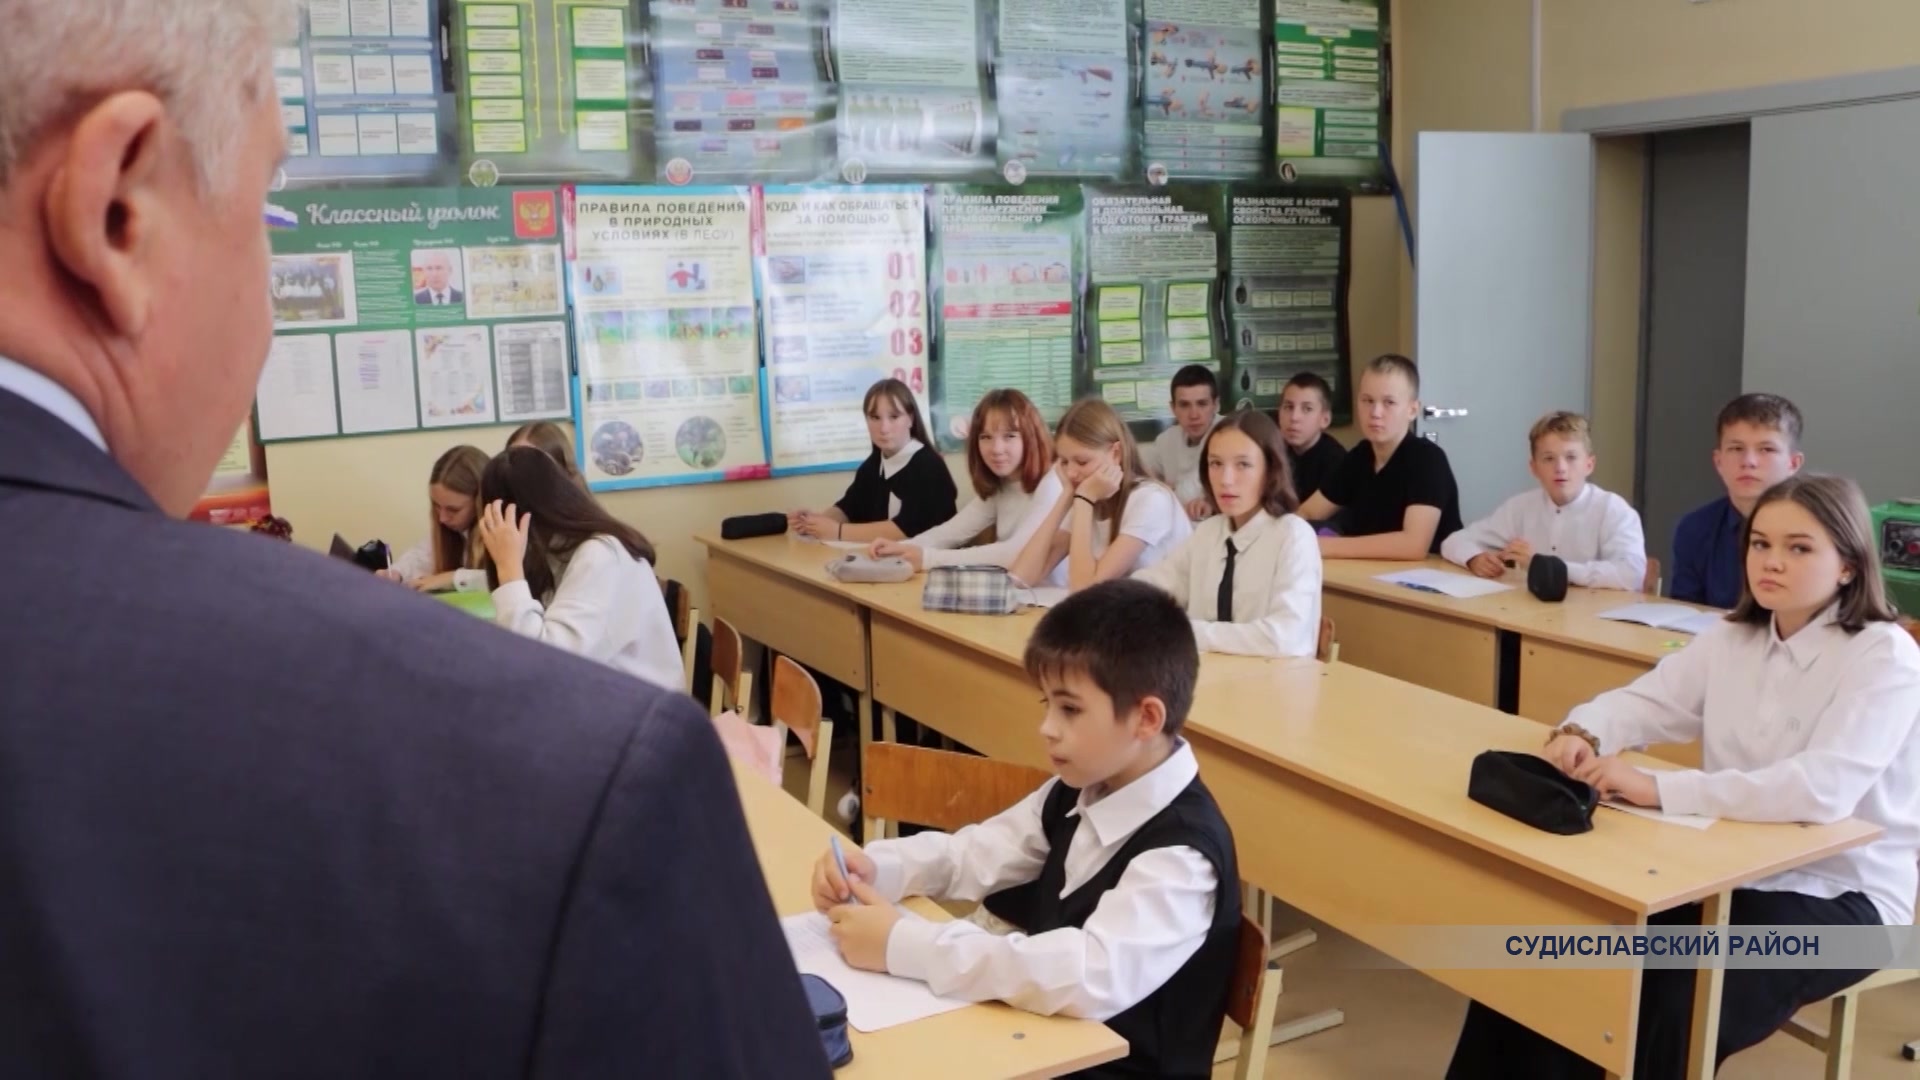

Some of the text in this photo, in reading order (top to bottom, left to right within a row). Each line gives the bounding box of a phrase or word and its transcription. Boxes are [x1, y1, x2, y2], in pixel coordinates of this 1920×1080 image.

[766, 201, 798, 213] КУДА
[801, 201, 810, 212] И
[814, 200, 836, 212] КАК
[943, 195, 1060, 205] ПРАВИЛА ПОВЕДЕНИЯ
[579, 201, 746, 214] ПРАВИЛА ПОВЕДЕНИЯ
[305, 202, 501, 230] Классный уголок
[608, 216, 714, 228] В ПРИРОДНЫХ
[817, 213, 890, 225] ПОМОЩЬЮ
[1092, 215, 1160, 225] ПОДГОТОВКА
[592, 228, 735, 241] УСЛОВИЯХ (В ЛЕСУ)
[888, 252, 916, 279] 01
[889, 290, 921, 318] 02
[890, 327, 923, 356] 03
